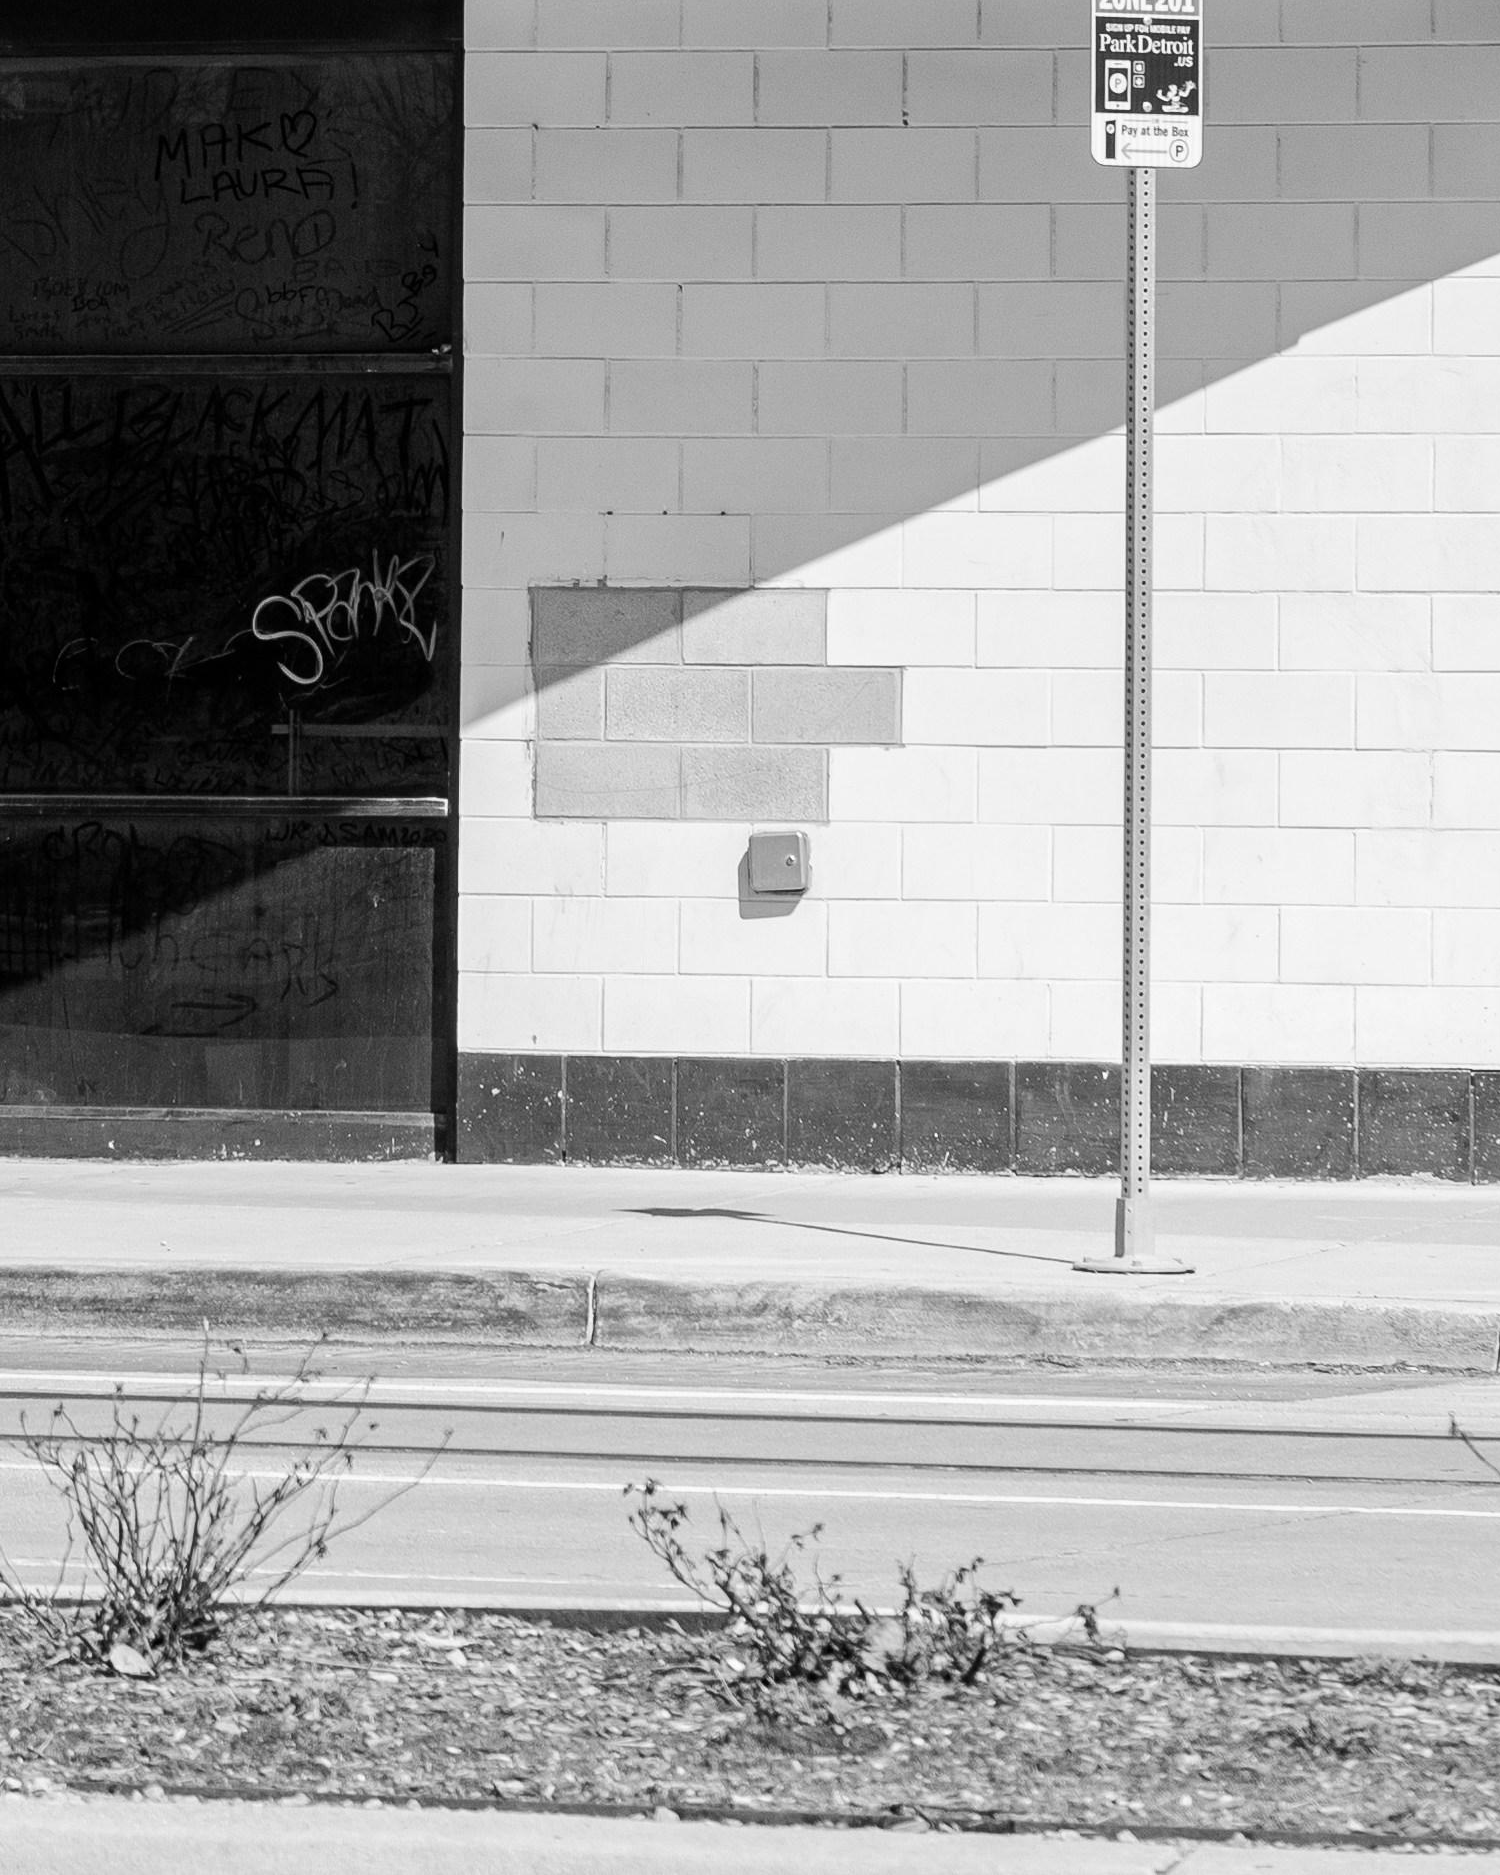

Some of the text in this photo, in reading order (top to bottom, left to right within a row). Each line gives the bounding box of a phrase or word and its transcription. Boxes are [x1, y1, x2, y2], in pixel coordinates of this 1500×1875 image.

[1105, 23, 1191, 35] SIGN UP FOR MOBILE PAY
[1173, 56, 1194, 67] .US
[1121, 125, 1189, 138] Pay at the Box
[1175, 145, 1184, 157] P
